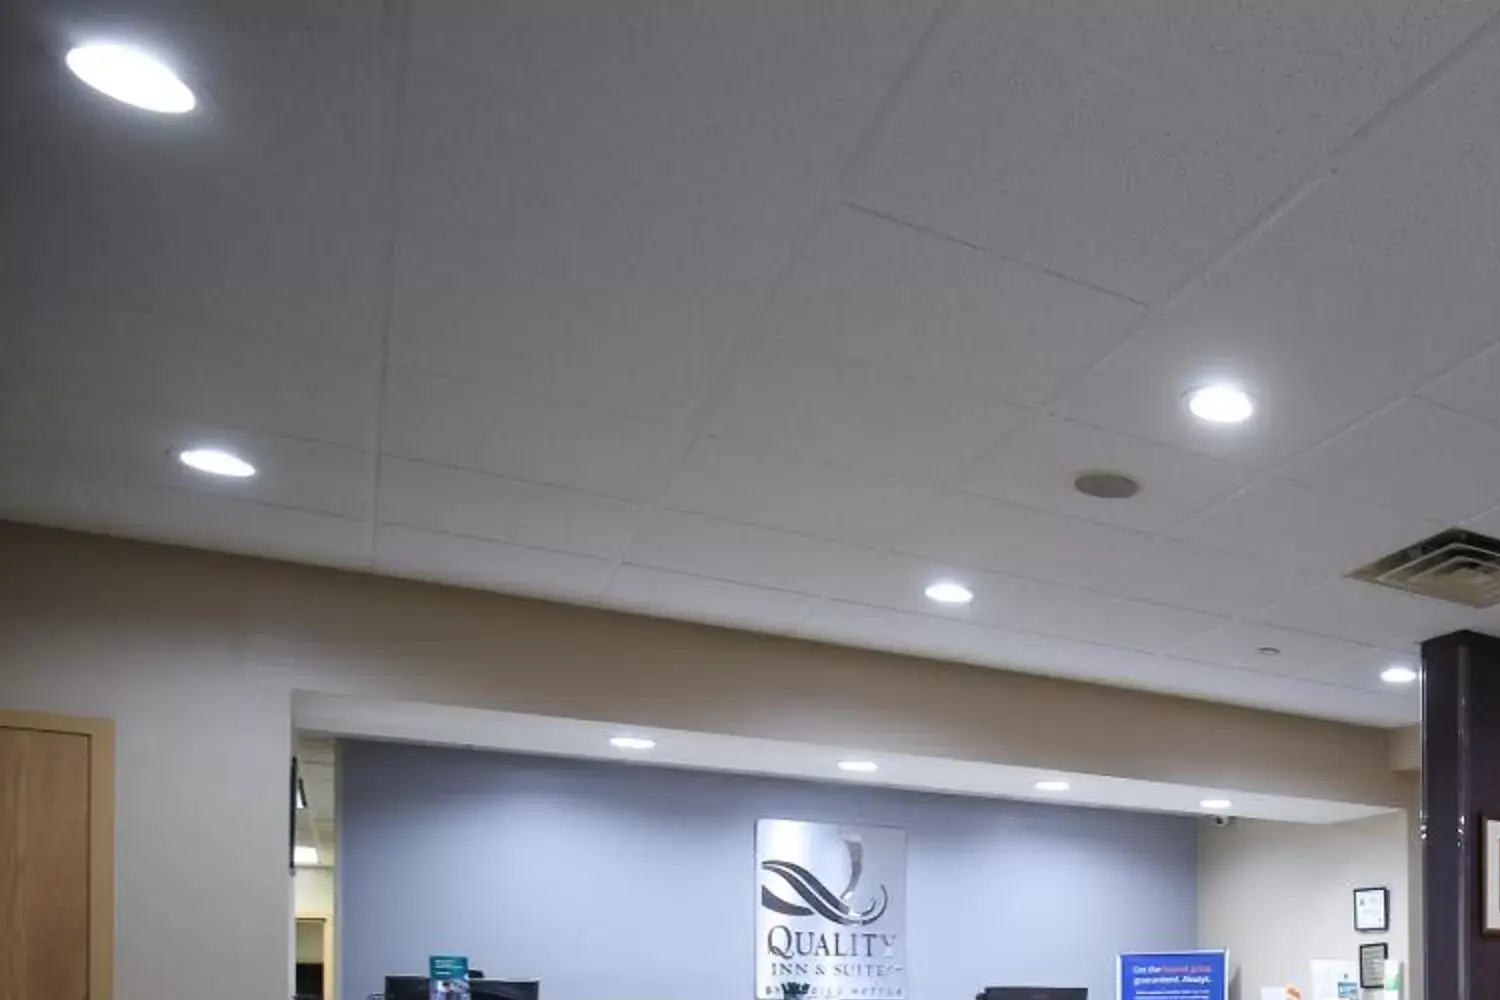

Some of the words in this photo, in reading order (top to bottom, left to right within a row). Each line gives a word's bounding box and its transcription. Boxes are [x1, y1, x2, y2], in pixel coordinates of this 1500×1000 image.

[767, 925, 897, 960] QUALITY
[771, 963, 809, 977] INN
[815, 964, 826, 976] &
